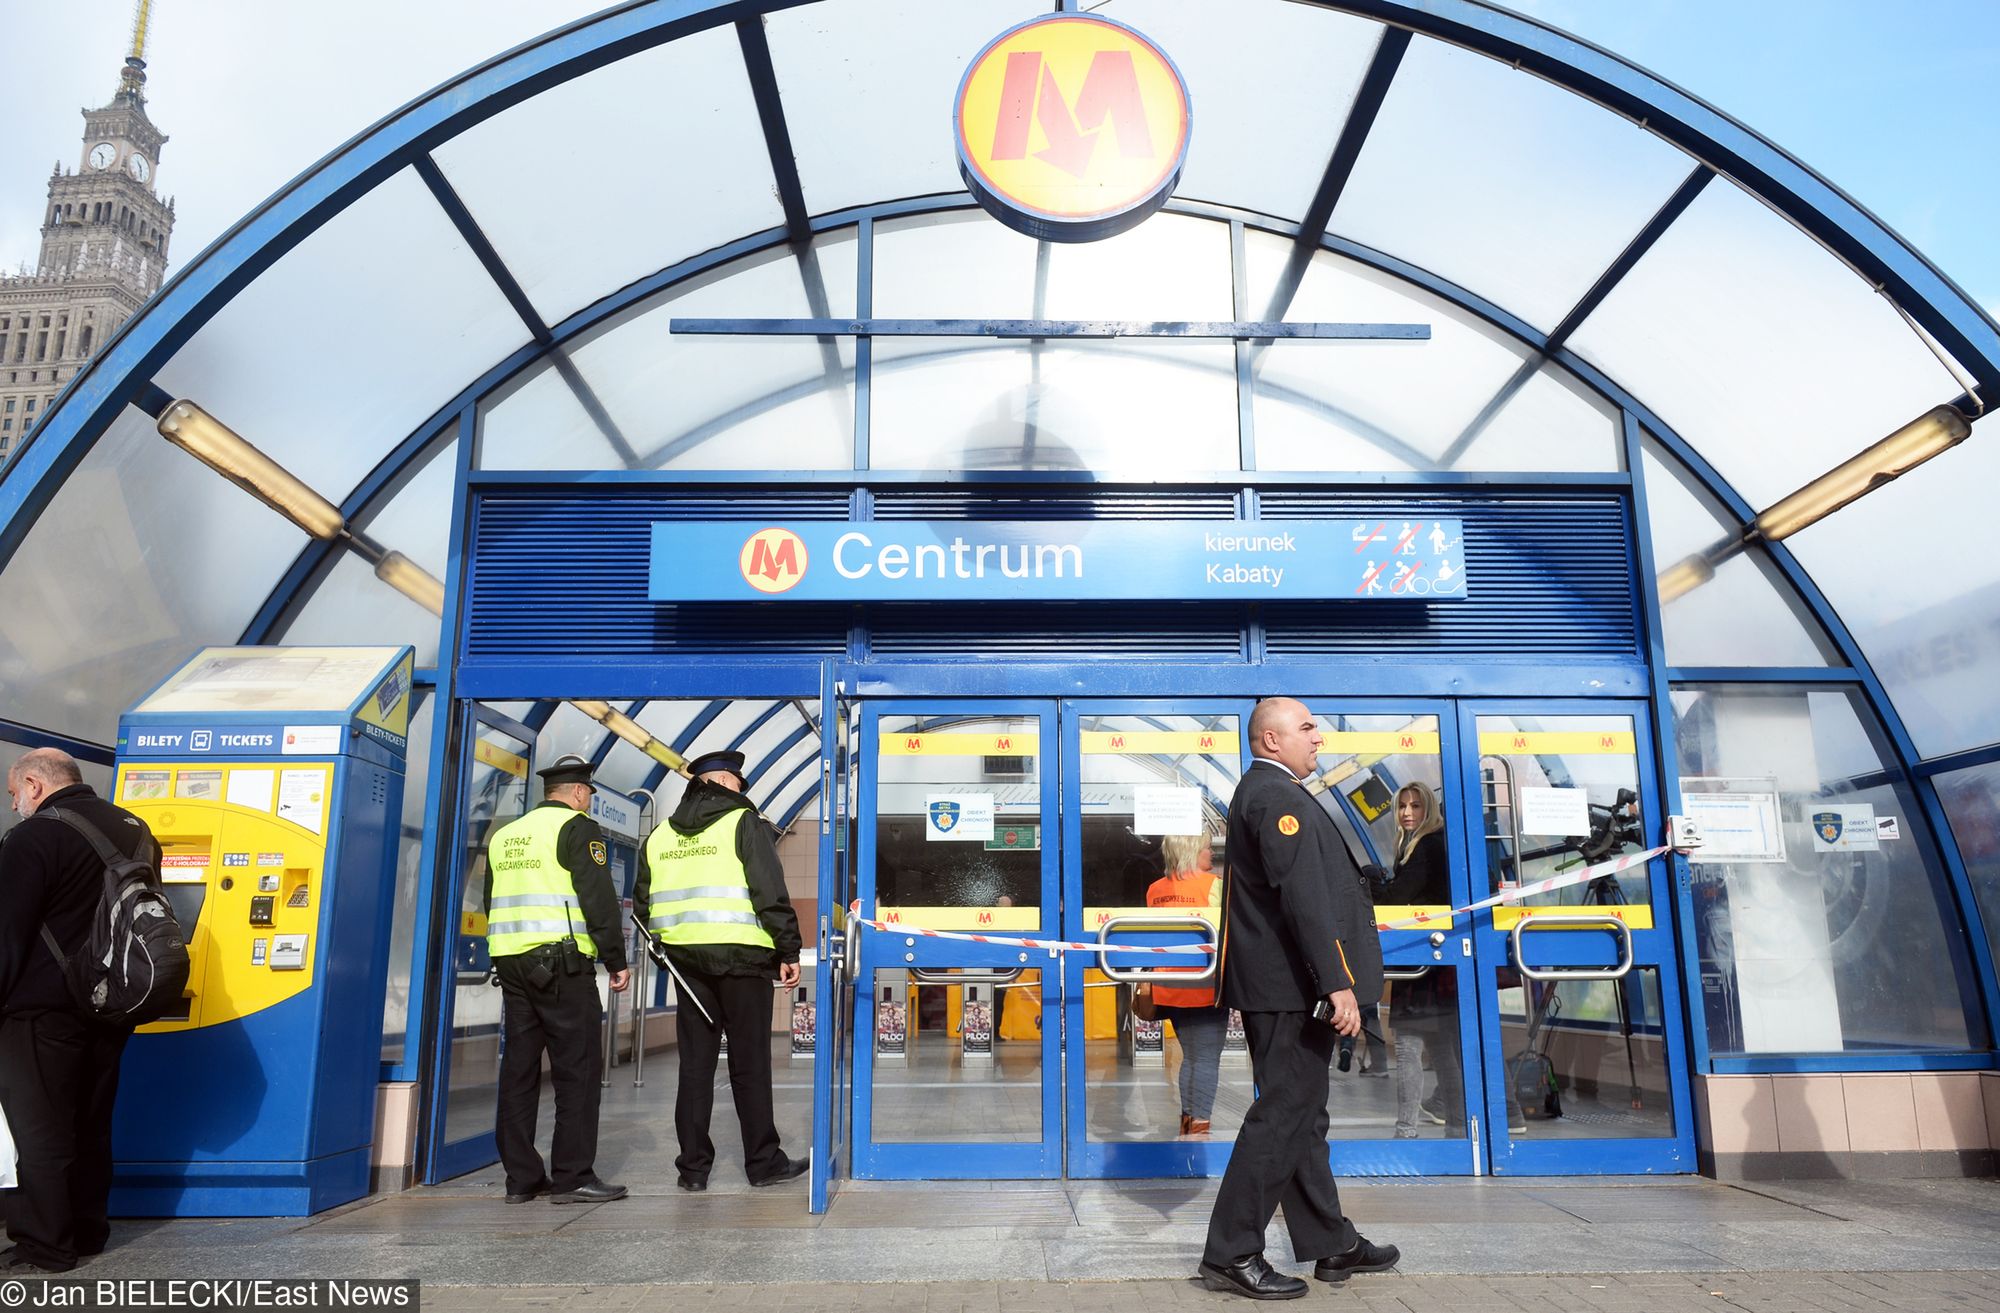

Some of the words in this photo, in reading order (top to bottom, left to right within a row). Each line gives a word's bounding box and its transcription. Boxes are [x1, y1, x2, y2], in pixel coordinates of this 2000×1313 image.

[990, 50, 1156, 179] M
[1204, 532, 1297, 552] kierunek
[748, 538, 799, 583] M
[832, 531, 1084, 580] Centrum
[1206, 563, 1284, 588] Kabaty
[137, 735, 183, 747] BILETY
[220, 734, 274, 747] TICKETS
[366, 723, 406, 748] BILETY-TICKETS
[601, 799, 627, 826] Centrum
[503, 835, 532, 848] STRAŻ
[678, 837, 699, 848] METRA
[505, 848, 524, 858] METRA
[660, 846, 717, 860] WARSZAWSKIEGO
[496, 859, 541, 871] RSZAWSKIEGO
[794, 1033, 816, 1042] PILOC
[879, 1033, 904, 1042] PILOCI
[965, 1032, 990, 1041] PILOCI
[1136, 1030, 1161, 1039] PILOCI
[1226, 1030, 1246, 1039] LOCI
